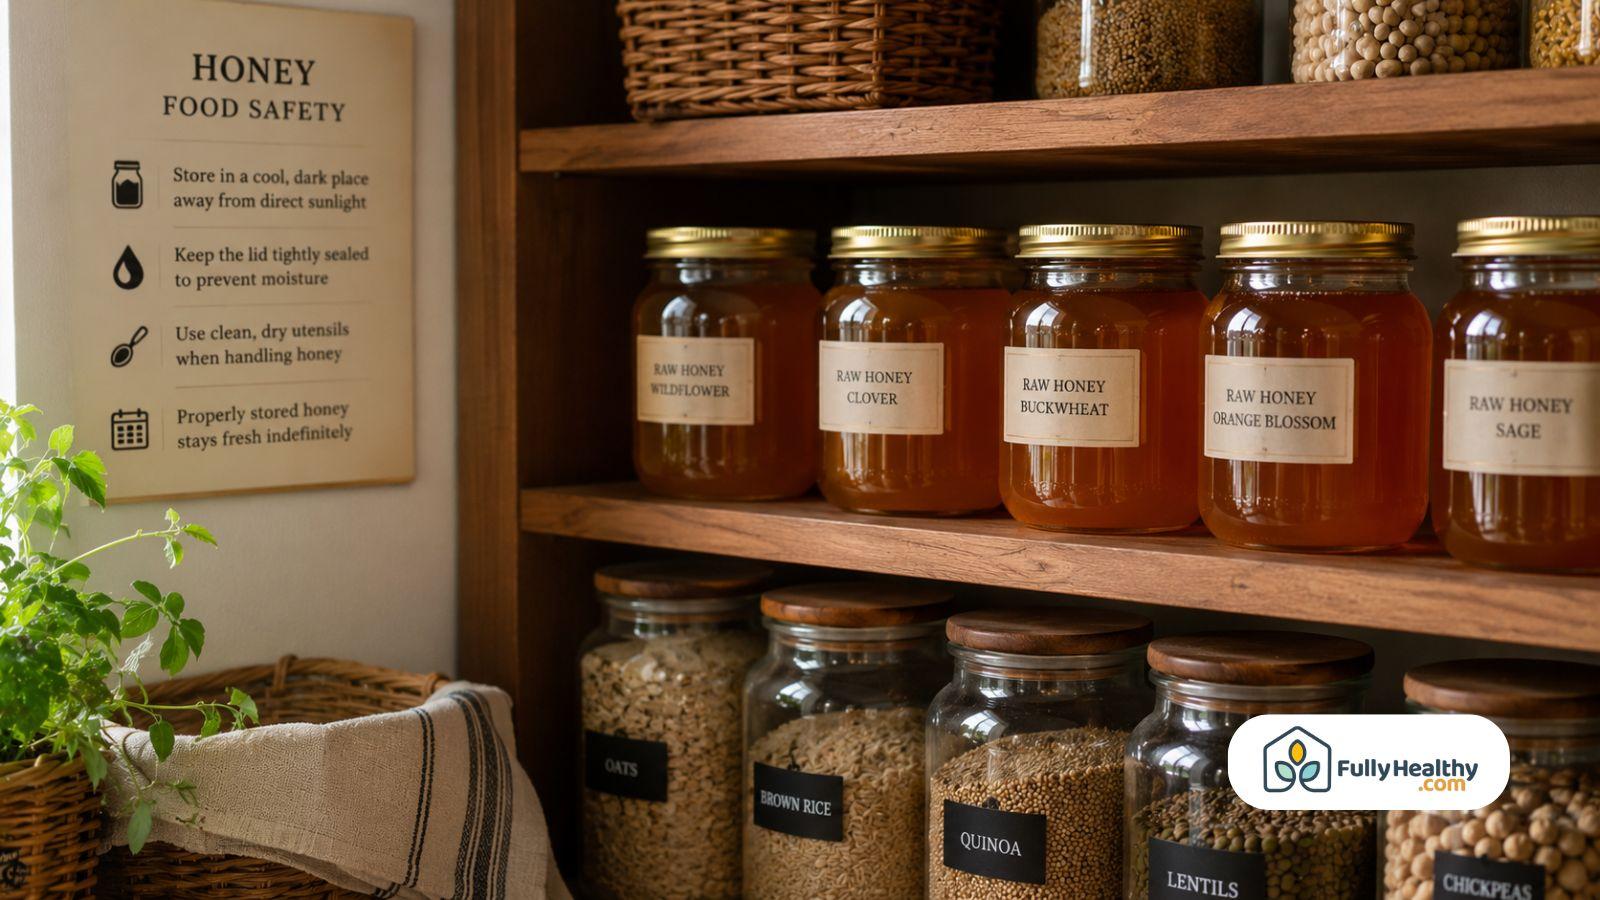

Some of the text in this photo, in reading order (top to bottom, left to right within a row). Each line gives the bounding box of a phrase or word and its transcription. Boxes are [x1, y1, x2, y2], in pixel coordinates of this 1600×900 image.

[192, 53, 316, 86] HONEY
[162, 95, 346, 122] FOOD SAFETY
[173, 167, 369, 188] Store in a cool, dark place
[173, 193, 367, 213] away from direct sunlight
[174, 247, 370, 265] Keep the lid tightly sealed
[175, 272, 329, 291] to prevent moisture
[175, 321, 350, 342] Use clean, dry utensils
[176, 347, 343, 367] when handling honey
[654, 363, 725, 377] RAW HONEY
[837, 370, 913, 384] RAW HONEY
[651, 383, 730, 398] WILDFLOWER
[1023, 378, 1106, 393] RAW HONEY
[847, 392, 898, 406] CLOVER
[1226, 389, 1317, 405] RAW HONEY
[1469, 396, 1574, 413] RAW HONEY
[177, 402, 349, 427] Properly stored honey
[1020, 400, 1109, 417] BUCKWHEAT
[1213, 411, 1336, 430] ORANGE BLOSSOM
[177, 424, 353, 451] stays fresh indefinitely
[1496, 423, 1542, 439] SAGE
[604, 758, 638, 777] OATS
[760, 790, 832, 816] BROWN RICE
[960, 831, 1022, 856] QUINOA
[1167, 870, 1239, 899] LENTILS
[1443, 873, 1532, 900] CHICKPEAS
